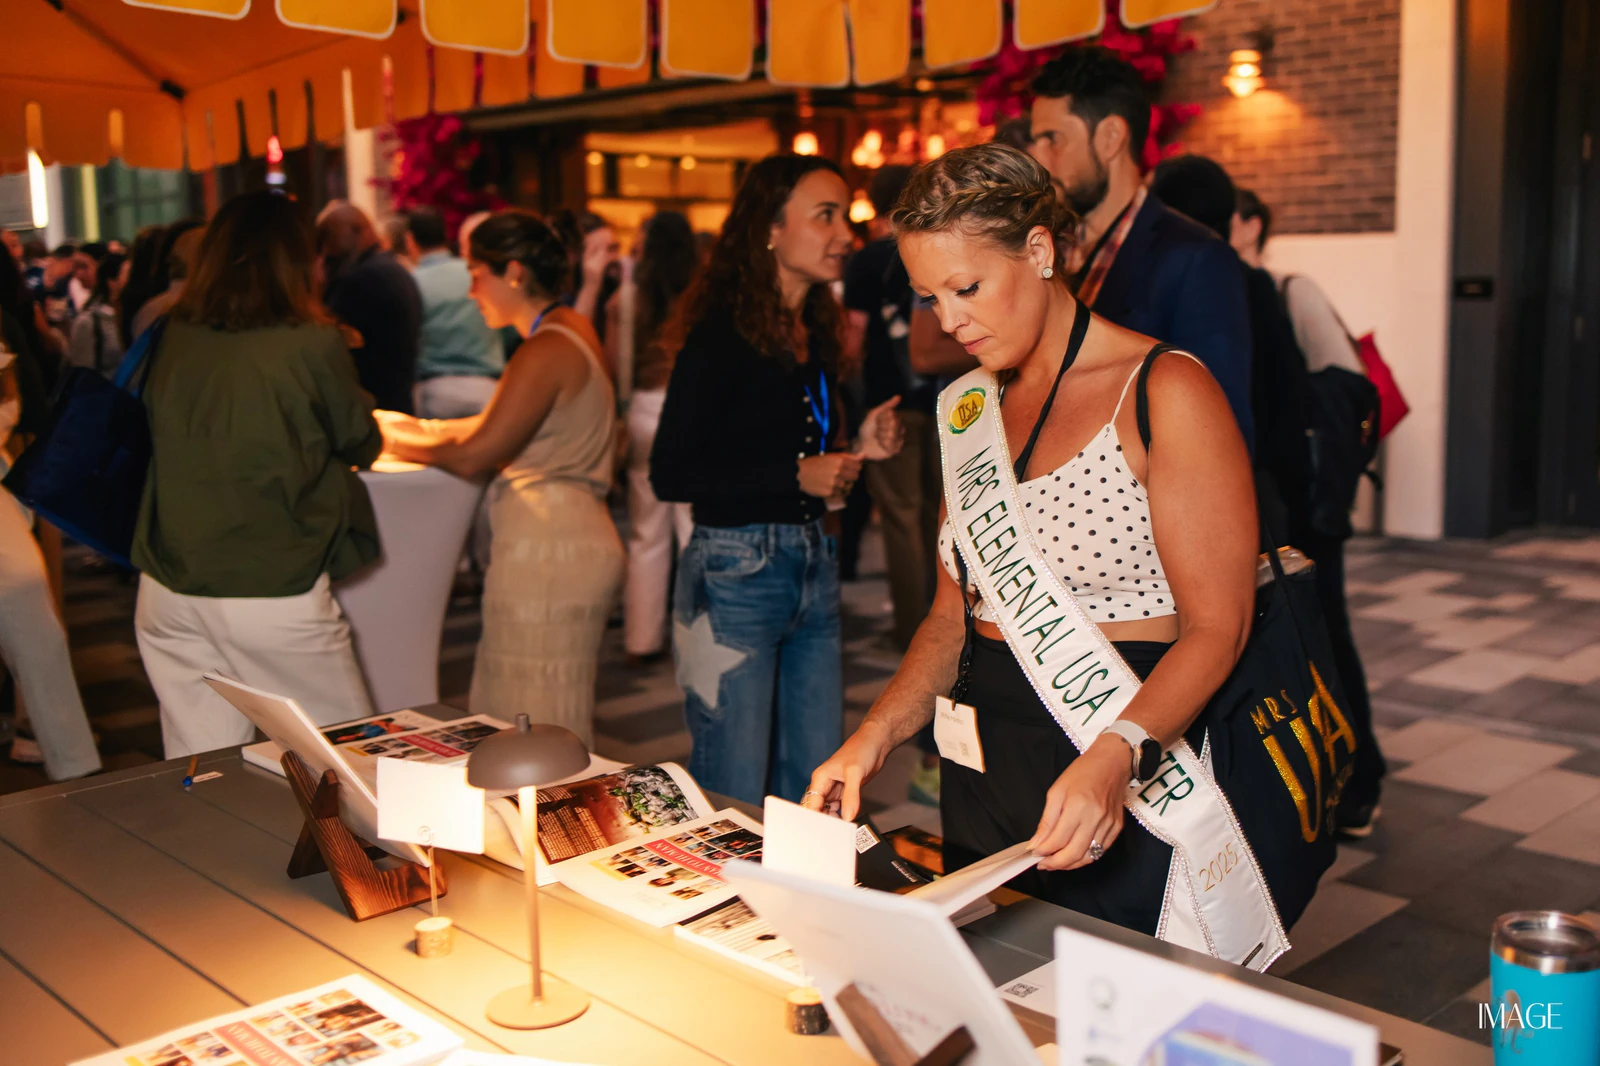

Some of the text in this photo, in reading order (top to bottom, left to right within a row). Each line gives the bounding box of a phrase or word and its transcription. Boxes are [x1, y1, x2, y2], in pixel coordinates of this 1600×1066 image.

[957, 399, 979, 421] USA
[955, 445, 1000, 511] MRS
[967, 500, 1076, 667] ELEMENTAL
[1051, 651, 1120, 727] USA
[1249, 689, 1298, 735] MRS
[1199, 842, 1239, 892] 2025
